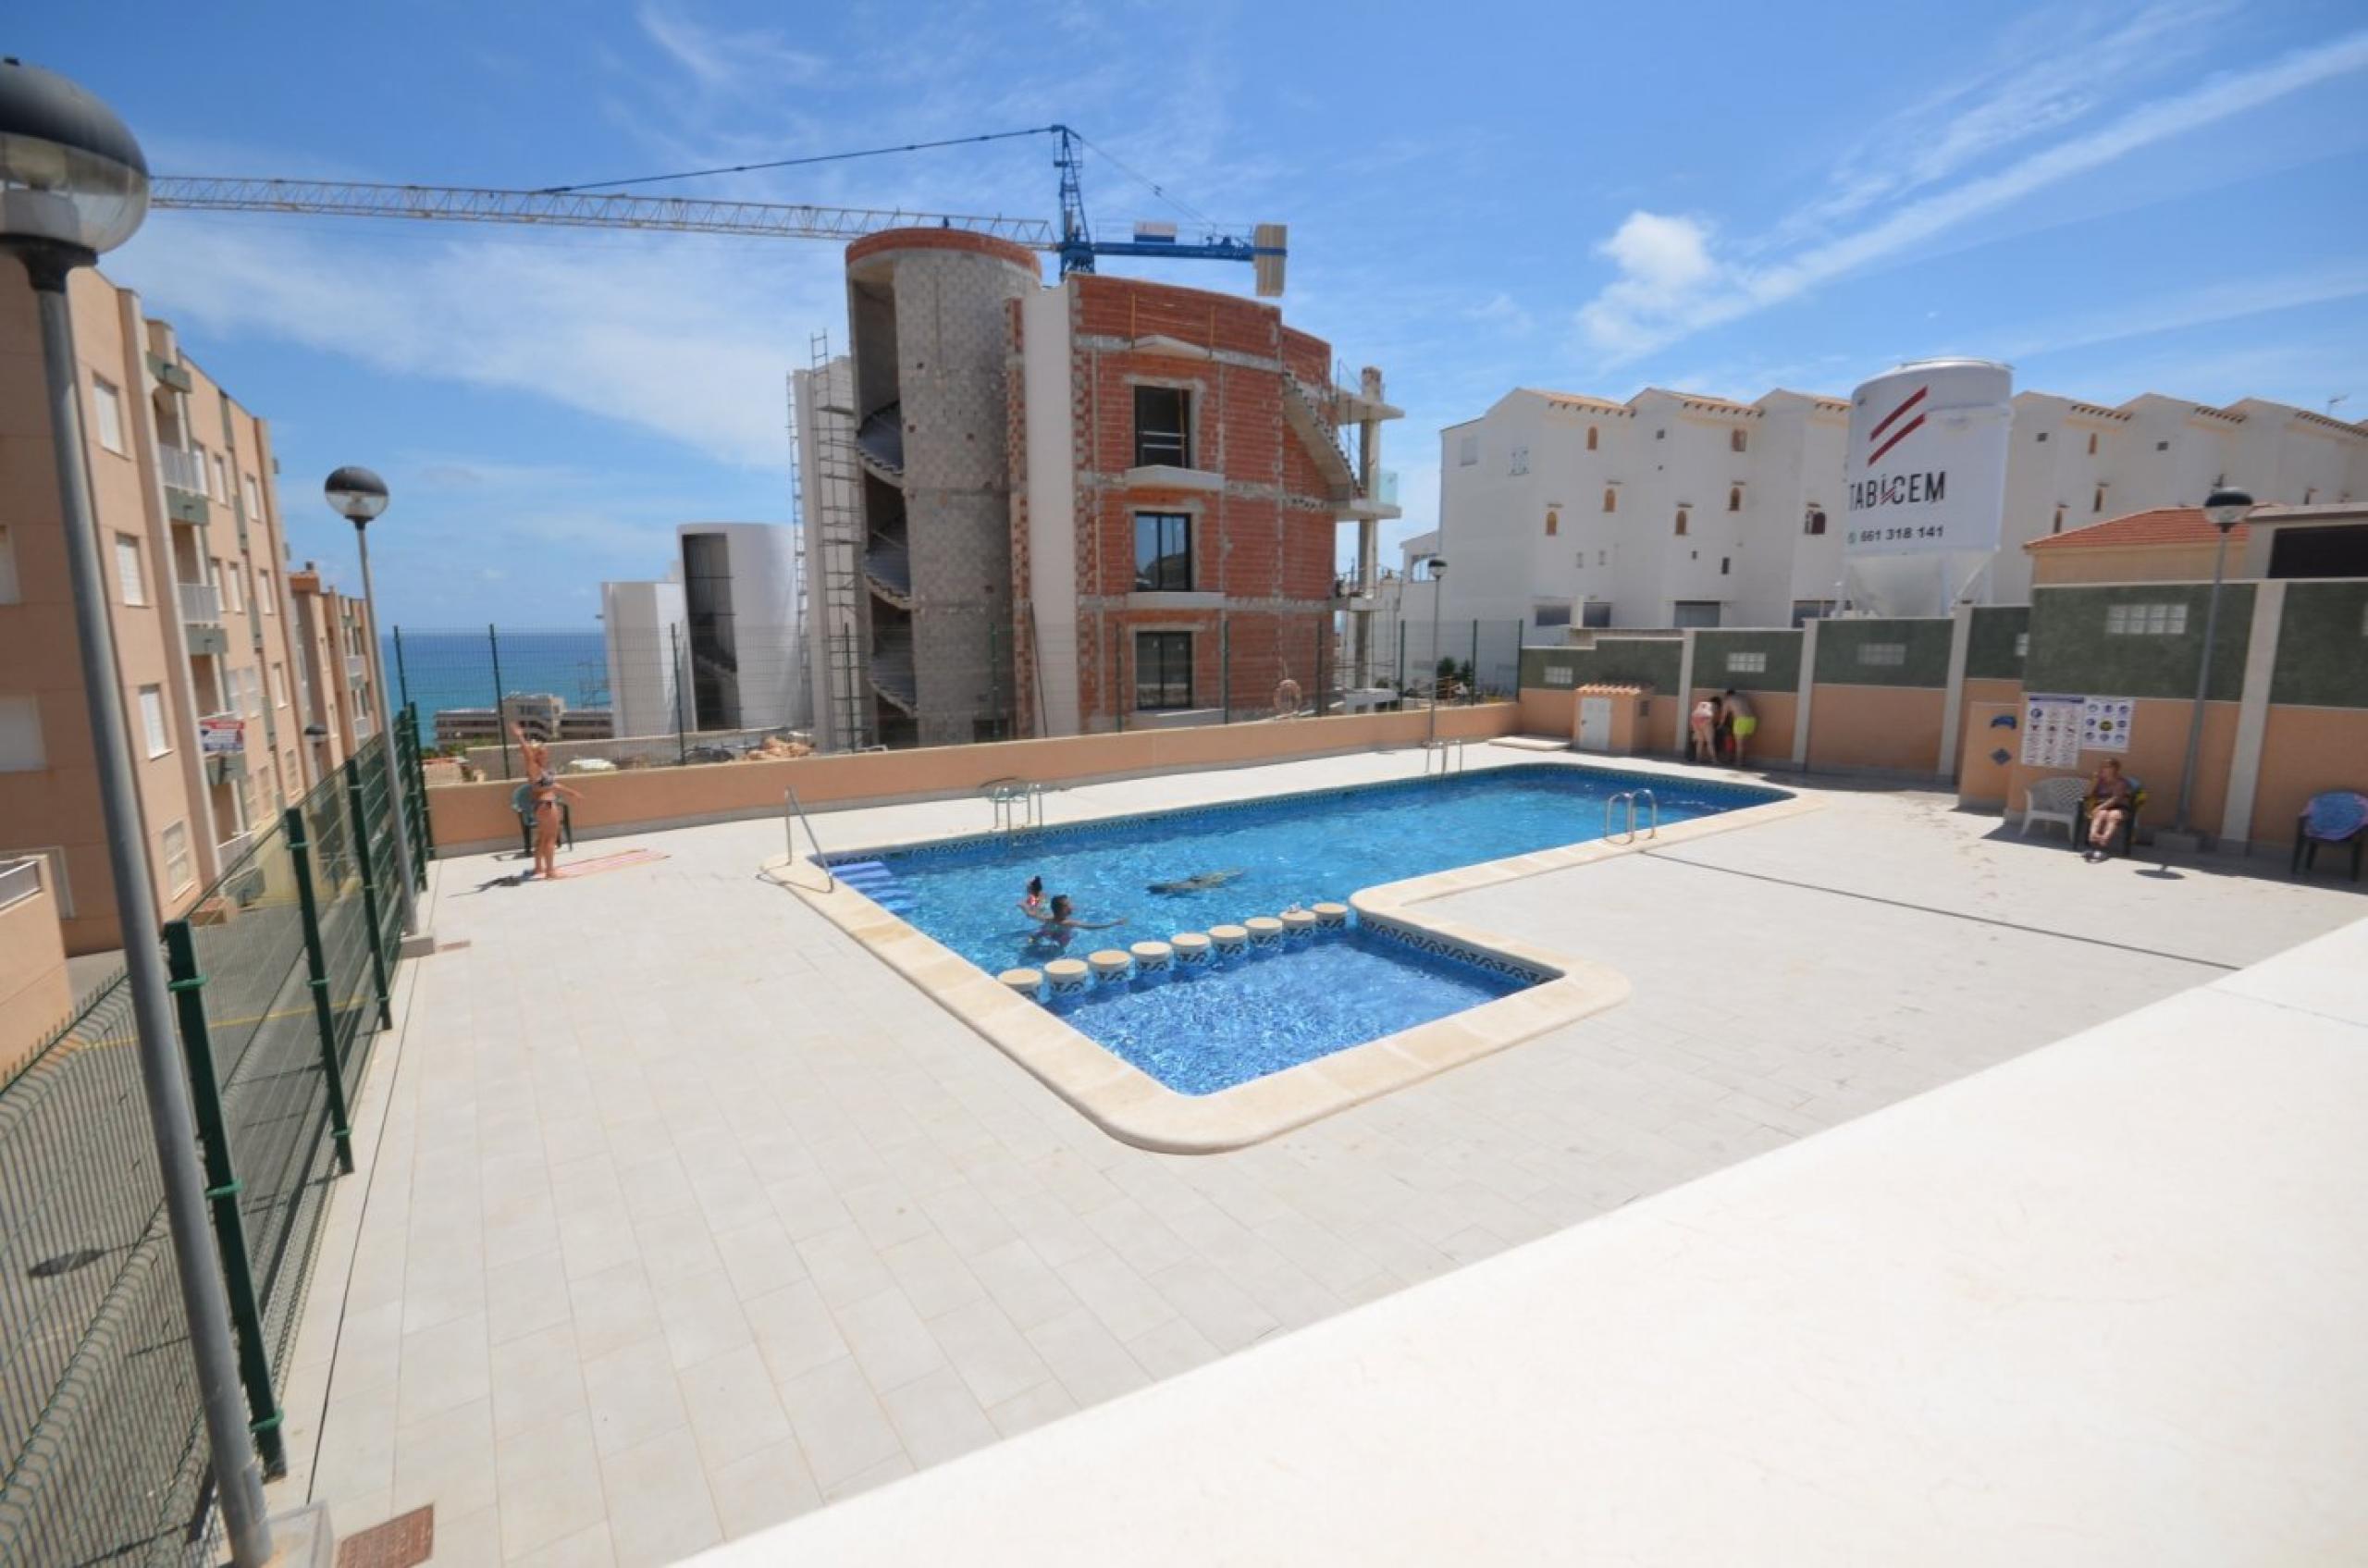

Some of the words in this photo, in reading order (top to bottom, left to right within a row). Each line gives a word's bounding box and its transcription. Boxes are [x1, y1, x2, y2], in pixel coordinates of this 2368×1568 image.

[1860, 529, 1881, 542] 661
[1885, 527, 1913, 540] 318
[1918, 525, 1943, 538] 141
